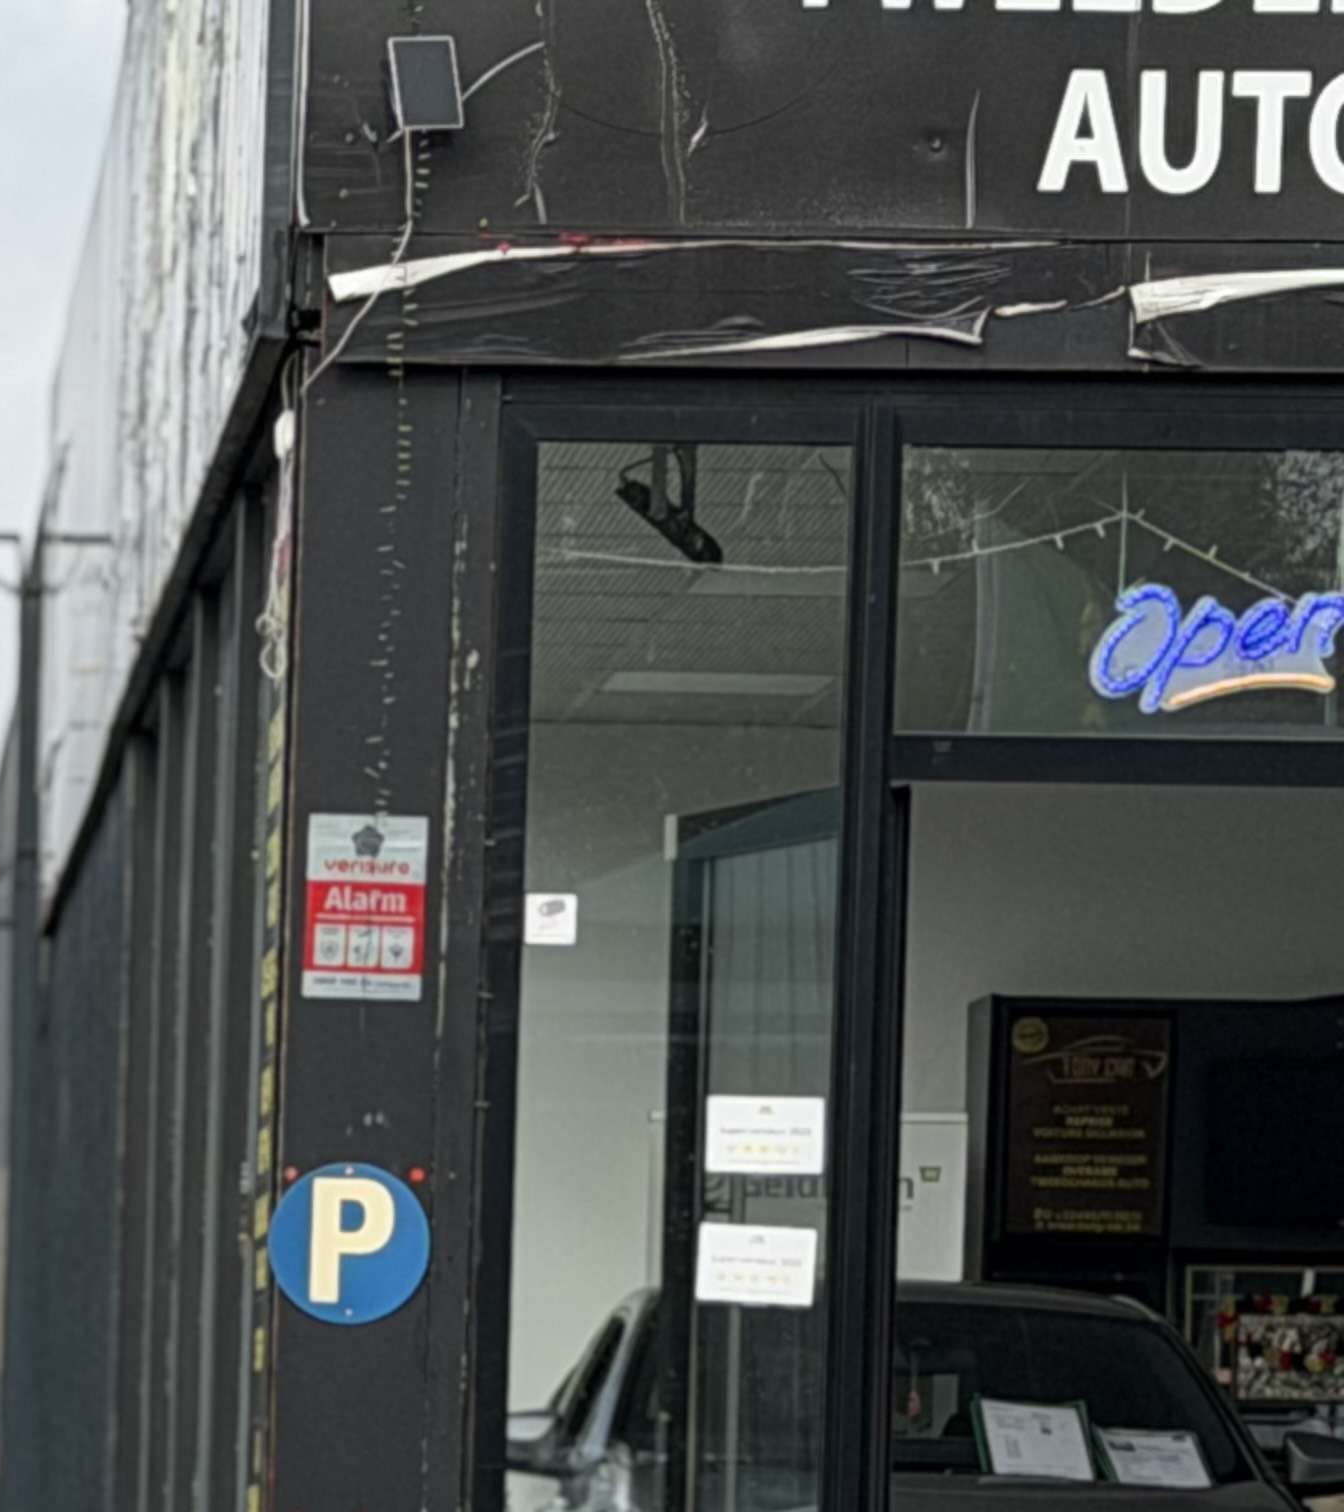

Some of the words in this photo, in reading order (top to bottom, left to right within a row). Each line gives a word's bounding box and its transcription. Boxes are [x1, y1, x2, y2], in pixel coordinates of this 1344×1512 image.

[1089, 584, 1344, 713] Open
[324, 886, 407, 913] Alarm
[308, 1177, 396, 1306] P
